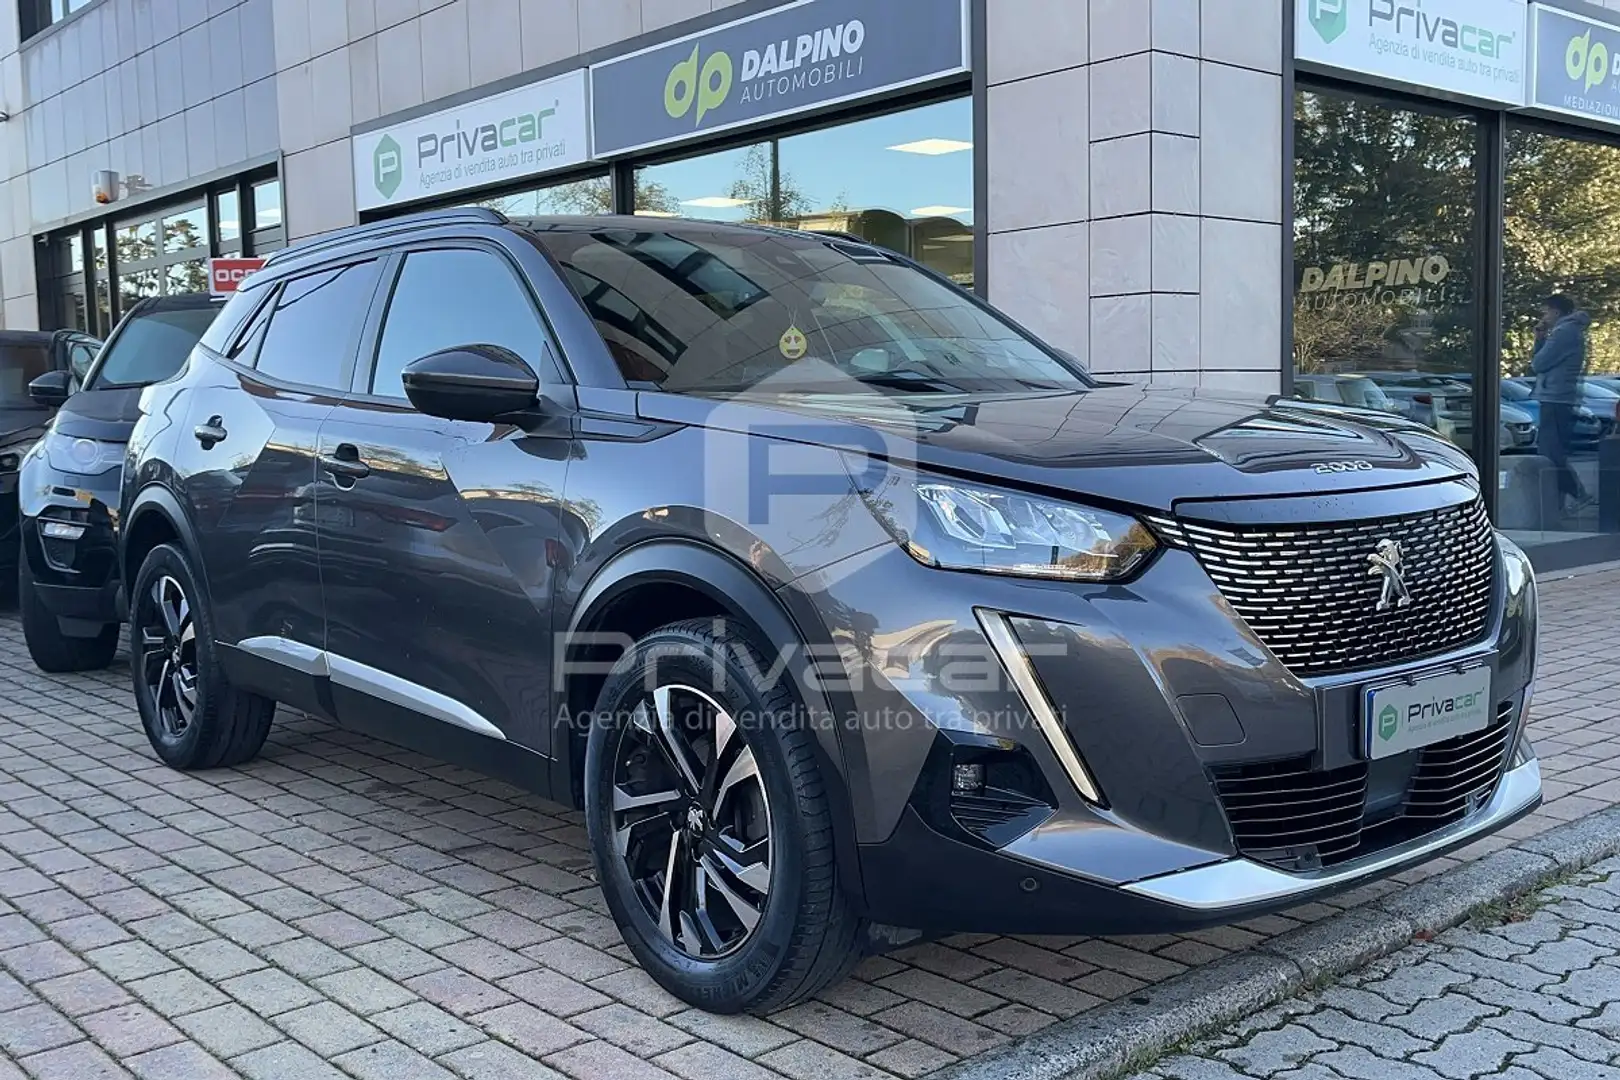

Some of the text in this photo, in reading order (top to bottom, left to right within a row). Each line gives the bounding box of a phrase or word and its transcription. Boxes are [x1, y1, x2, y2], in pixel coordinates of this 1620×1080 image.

[740, 19, 865, 83] DALPINO
[1369, 0, 1513, 59] Privacar
[1369, 33, 1408, 57] Agenzia
[1411, 43, 1420, 60] di
[1423, 48, 1456, 68] vendita
[1458, 57, 1478, 74] auto
[1480, 62, 1491, 77] tra
[740, 56, 864, 104] AUTOMOBILI
[1564, 94, 1620, 117] MEDIAZION
[417, 107, 556, 168] Privacar
[419, 139, 566, 189] Agenzia di vendita auto tra privati
[1300, 255, 1450, 293] DALPINO
[1300, 287, 1446, 311] AUTOMOBILI
[1408, 691, 1483, 722] Privacar
